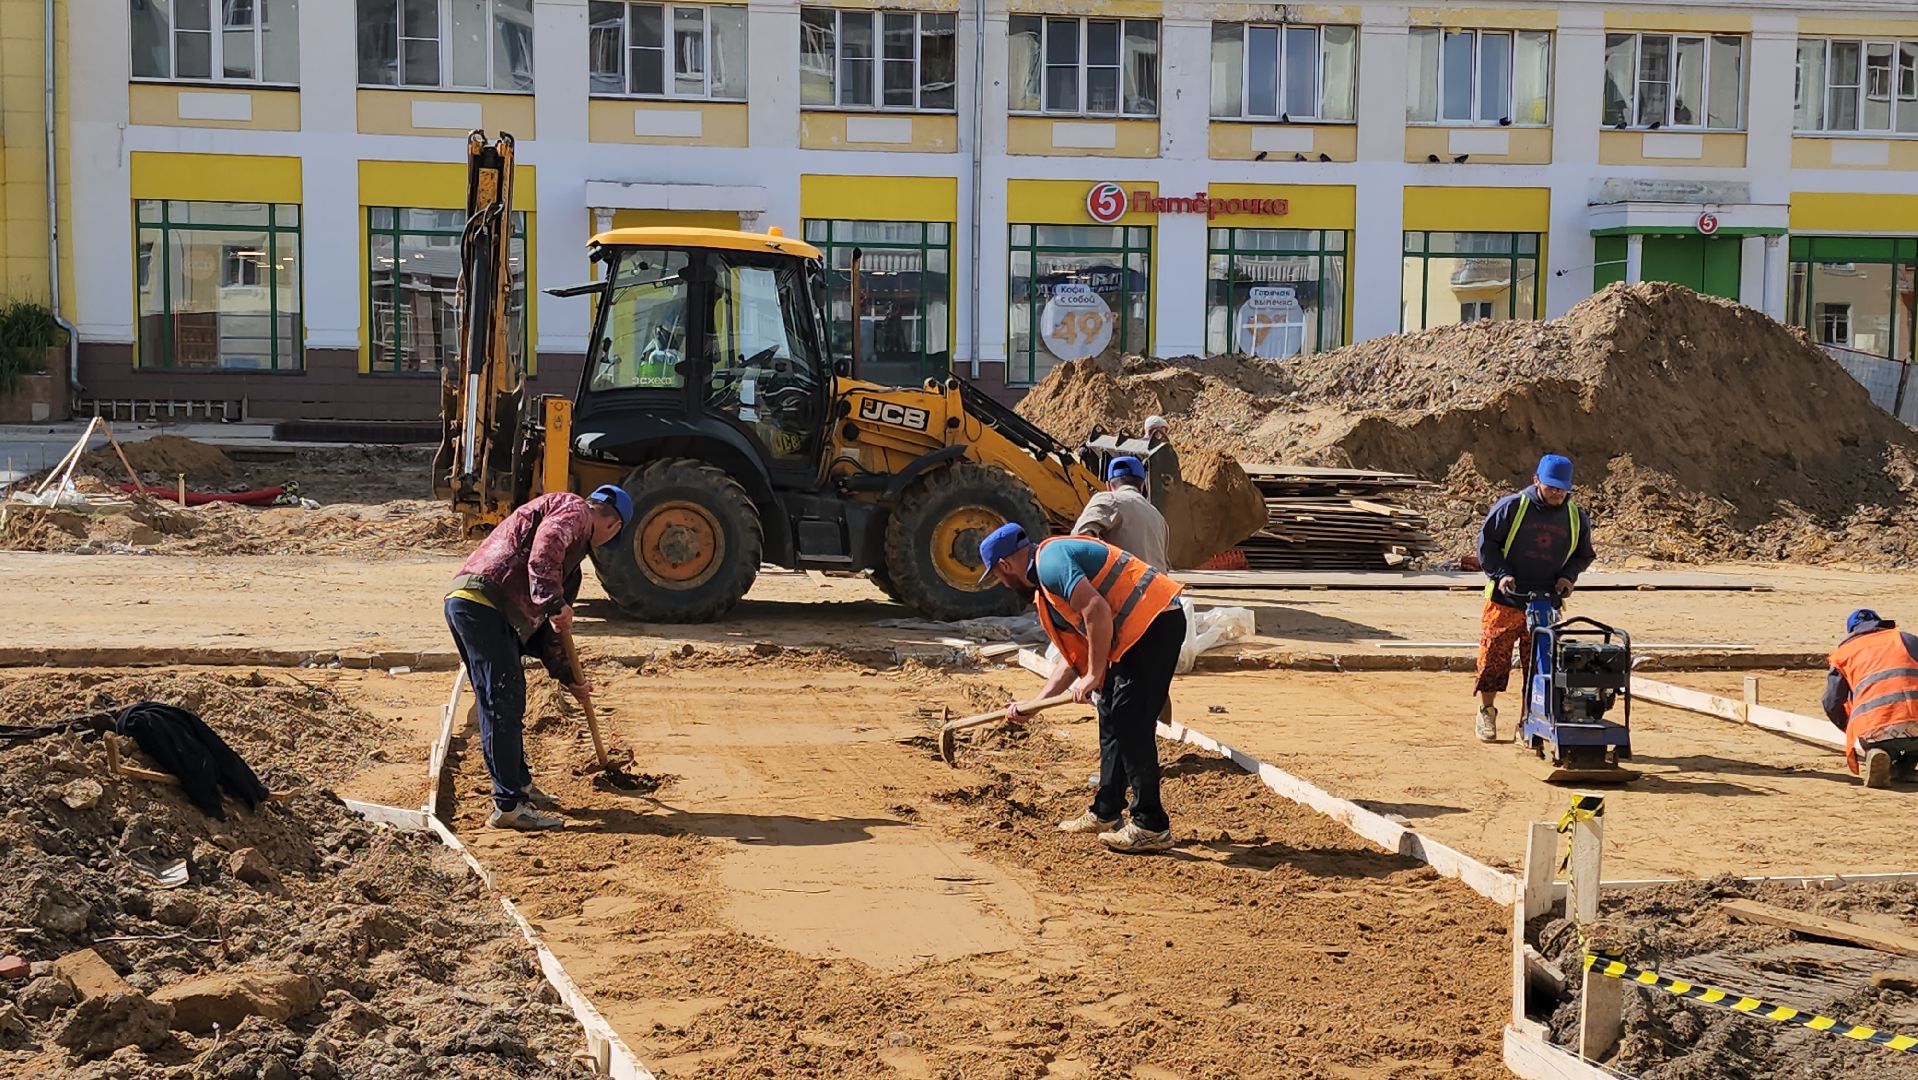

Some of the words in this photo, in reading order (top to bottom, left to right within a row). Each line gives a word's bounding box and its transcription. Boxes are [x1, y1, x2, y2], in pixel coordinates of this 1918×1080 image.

[1132, 191, 1289, 220] Пятёрочка
[1254, 288, 1291, 298] Горячая
[1060, 296, 1067, 304] с
[1067, 294, 1096, 304] собой
[1254, 298, 1293, 306] выпечка
[862, 400, 926, 429] JCB
